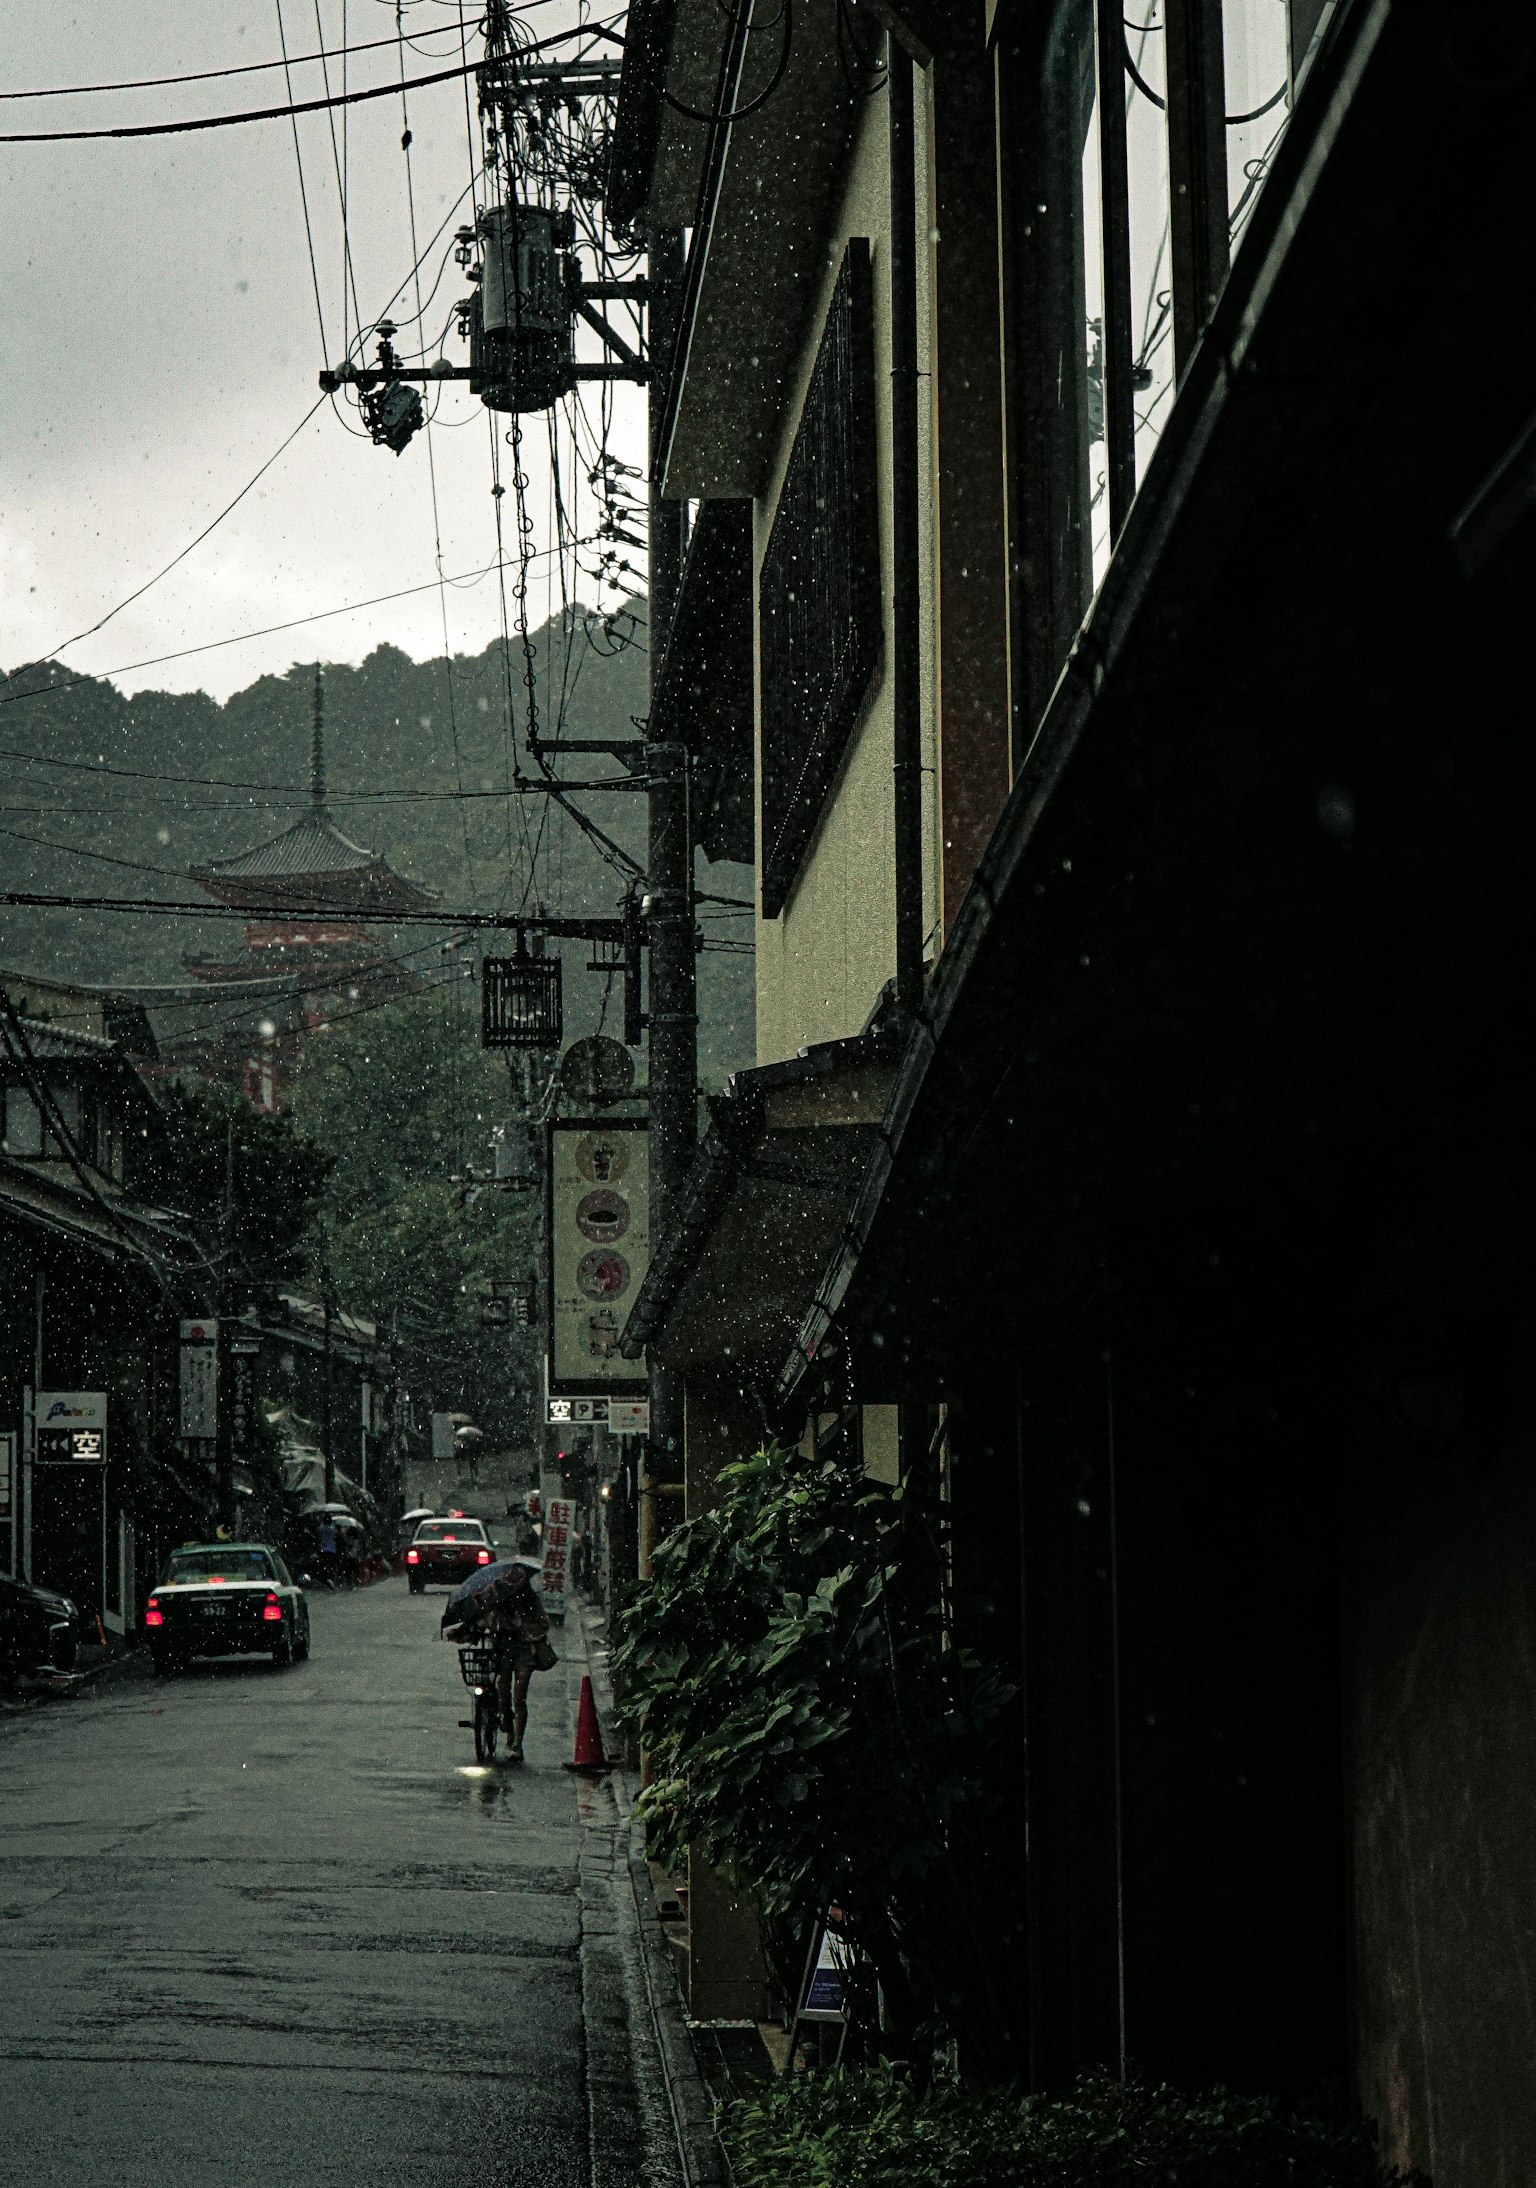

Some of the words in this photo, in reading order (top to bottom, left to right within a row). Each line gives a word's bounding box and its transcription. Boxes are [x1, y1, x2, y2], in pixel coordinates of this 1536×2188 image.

[549, 1399, 571, 1421] 空
[72, 1430, 102, 1459] 空
[544, 1503, 570, 1593] 駐車厳禁
